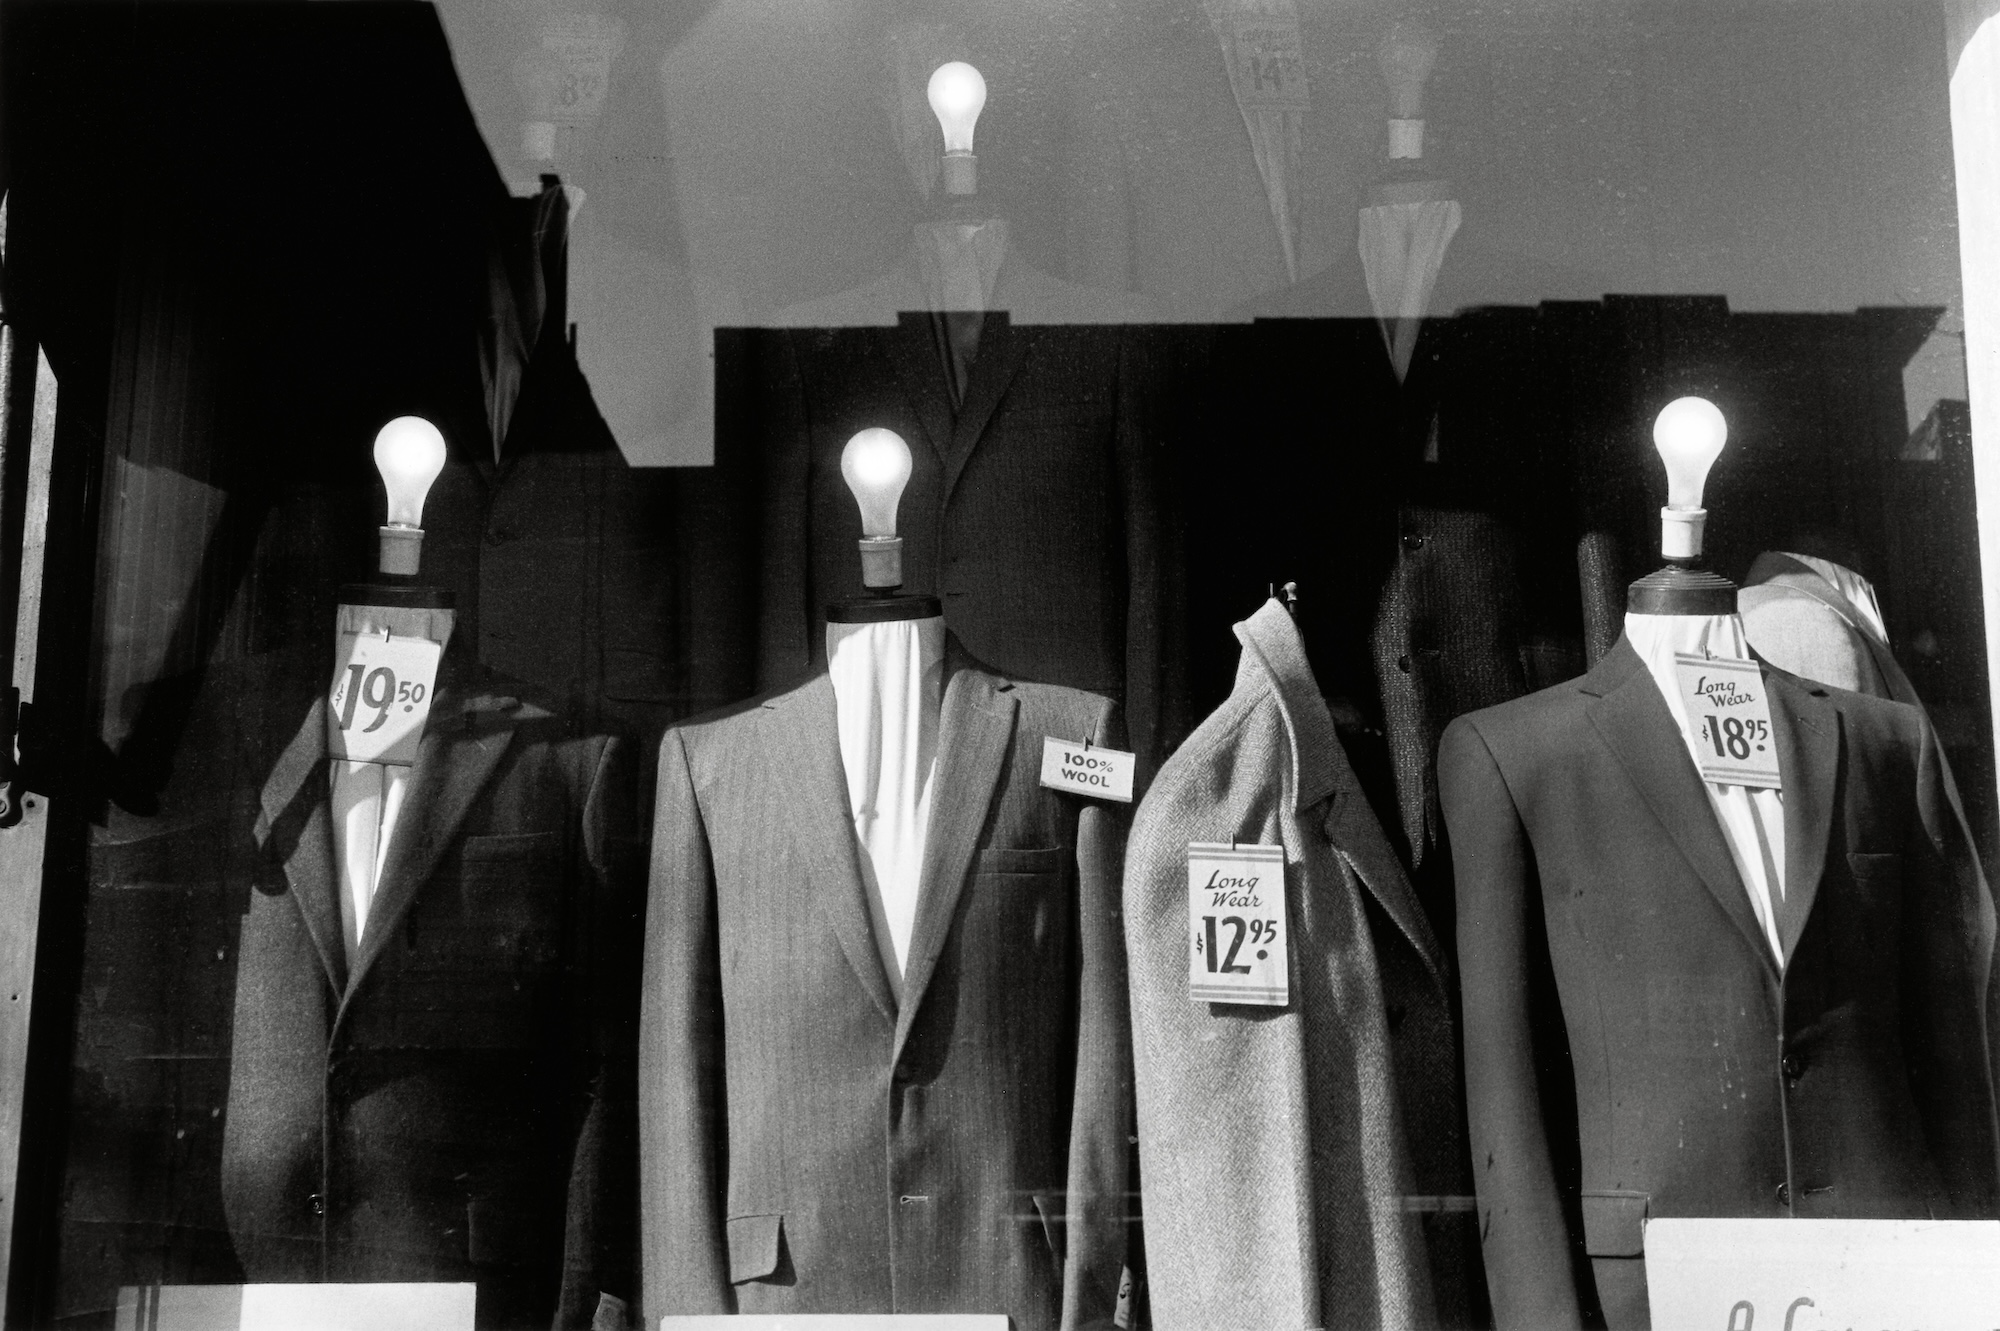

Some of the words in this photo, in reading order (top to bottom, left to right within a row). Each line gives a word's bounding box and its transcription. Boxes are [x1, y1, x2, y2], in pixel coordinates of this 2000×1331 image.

[1694, 675, 1736, 696] Long
[1708, 693, 1756, 707] Wear
[1064, 752, 1114, 773] 100%
[1061, 768, 1110, 787] WOOL
[1205, 869, 1260, 894] Long
[1212, 891, 1264, 907] Wear
